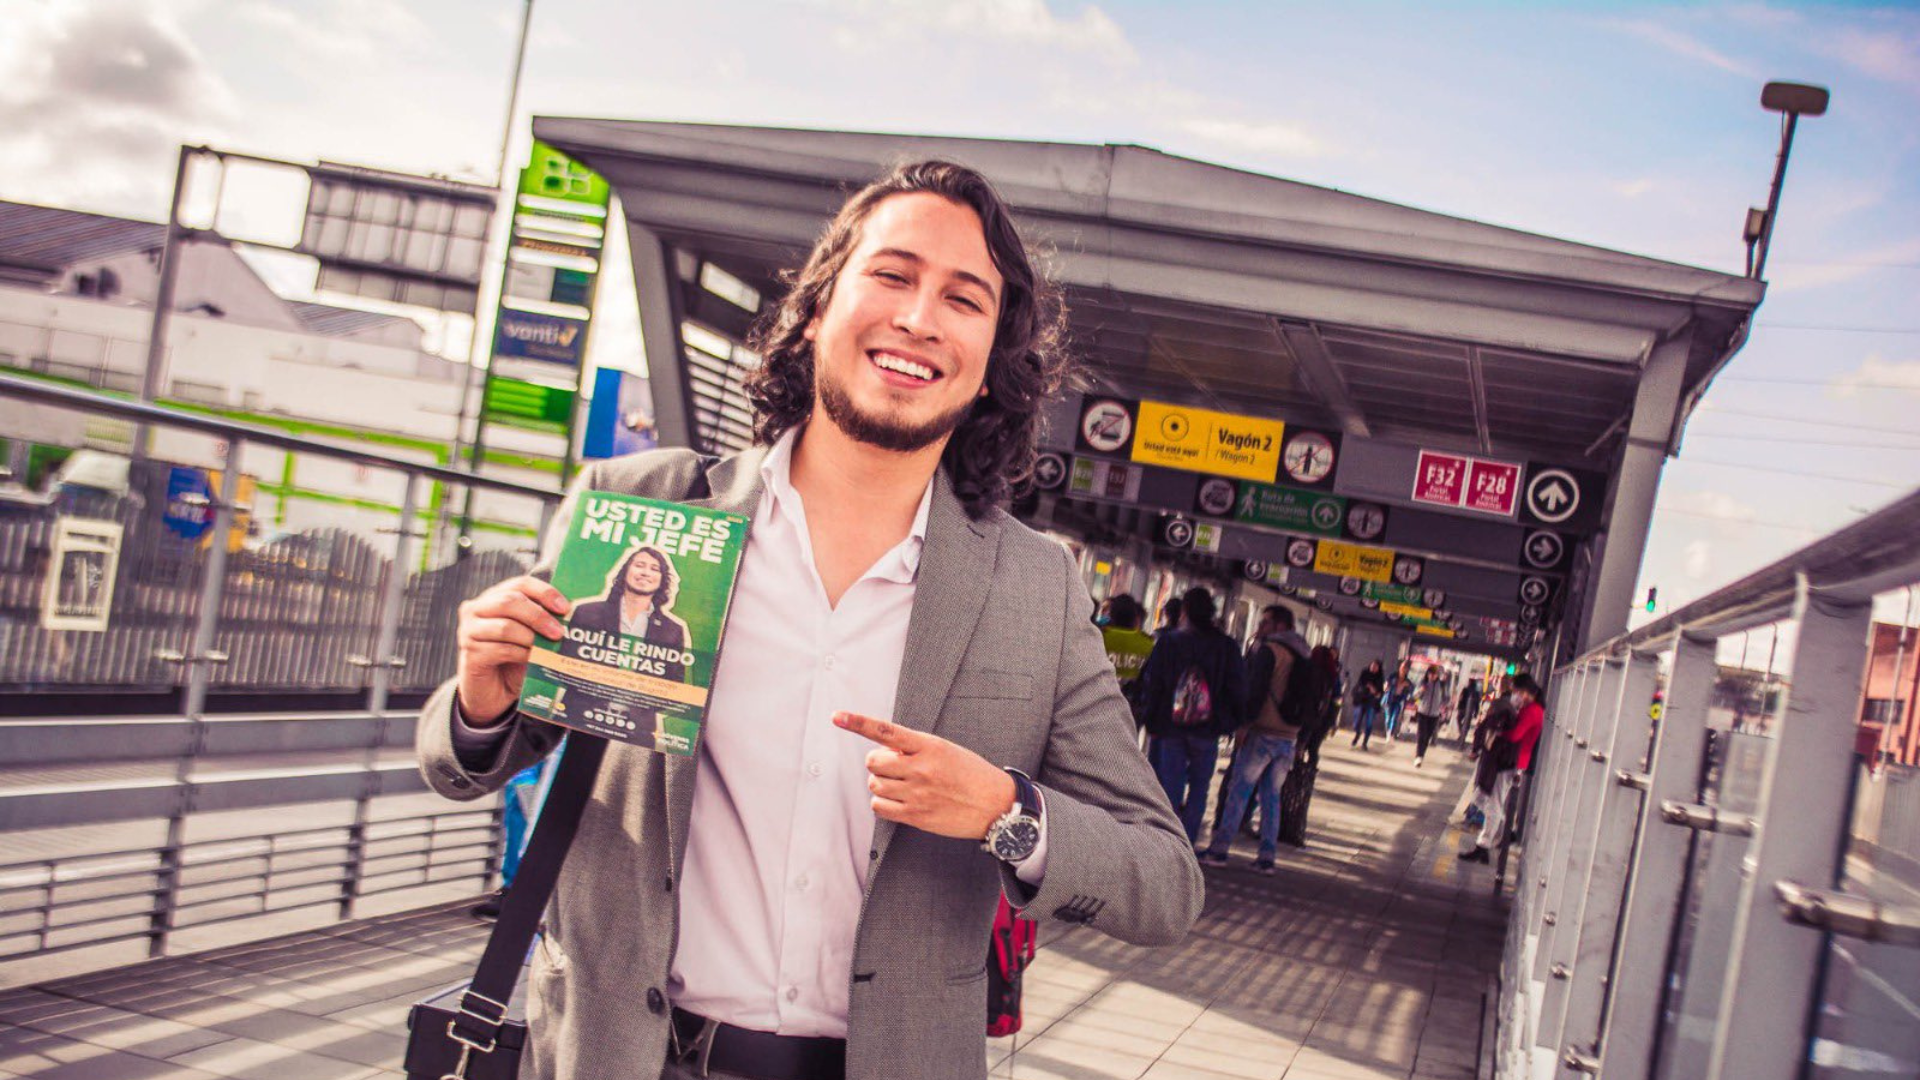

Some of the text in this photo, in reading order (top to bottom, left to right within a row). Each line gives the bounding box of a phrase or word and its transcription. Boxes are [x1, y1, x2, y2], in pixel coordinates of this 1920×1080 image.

[502, 321, 559, 345] vanti
[1218, 428, 1273, 451] Vagón 2
[1426, 464, 1455, 487] F32
[1477, 471, 1507, 495] F28
[585, 498, 731, 541] USTED ES
[580, 517, 726, 564] MI JEFE
[563, 625, 696, 666] AQUÍ LE RINDO
[577, 645, 666, 676] CUENTAS
[1108, 652, 1146, 669] OLIC
